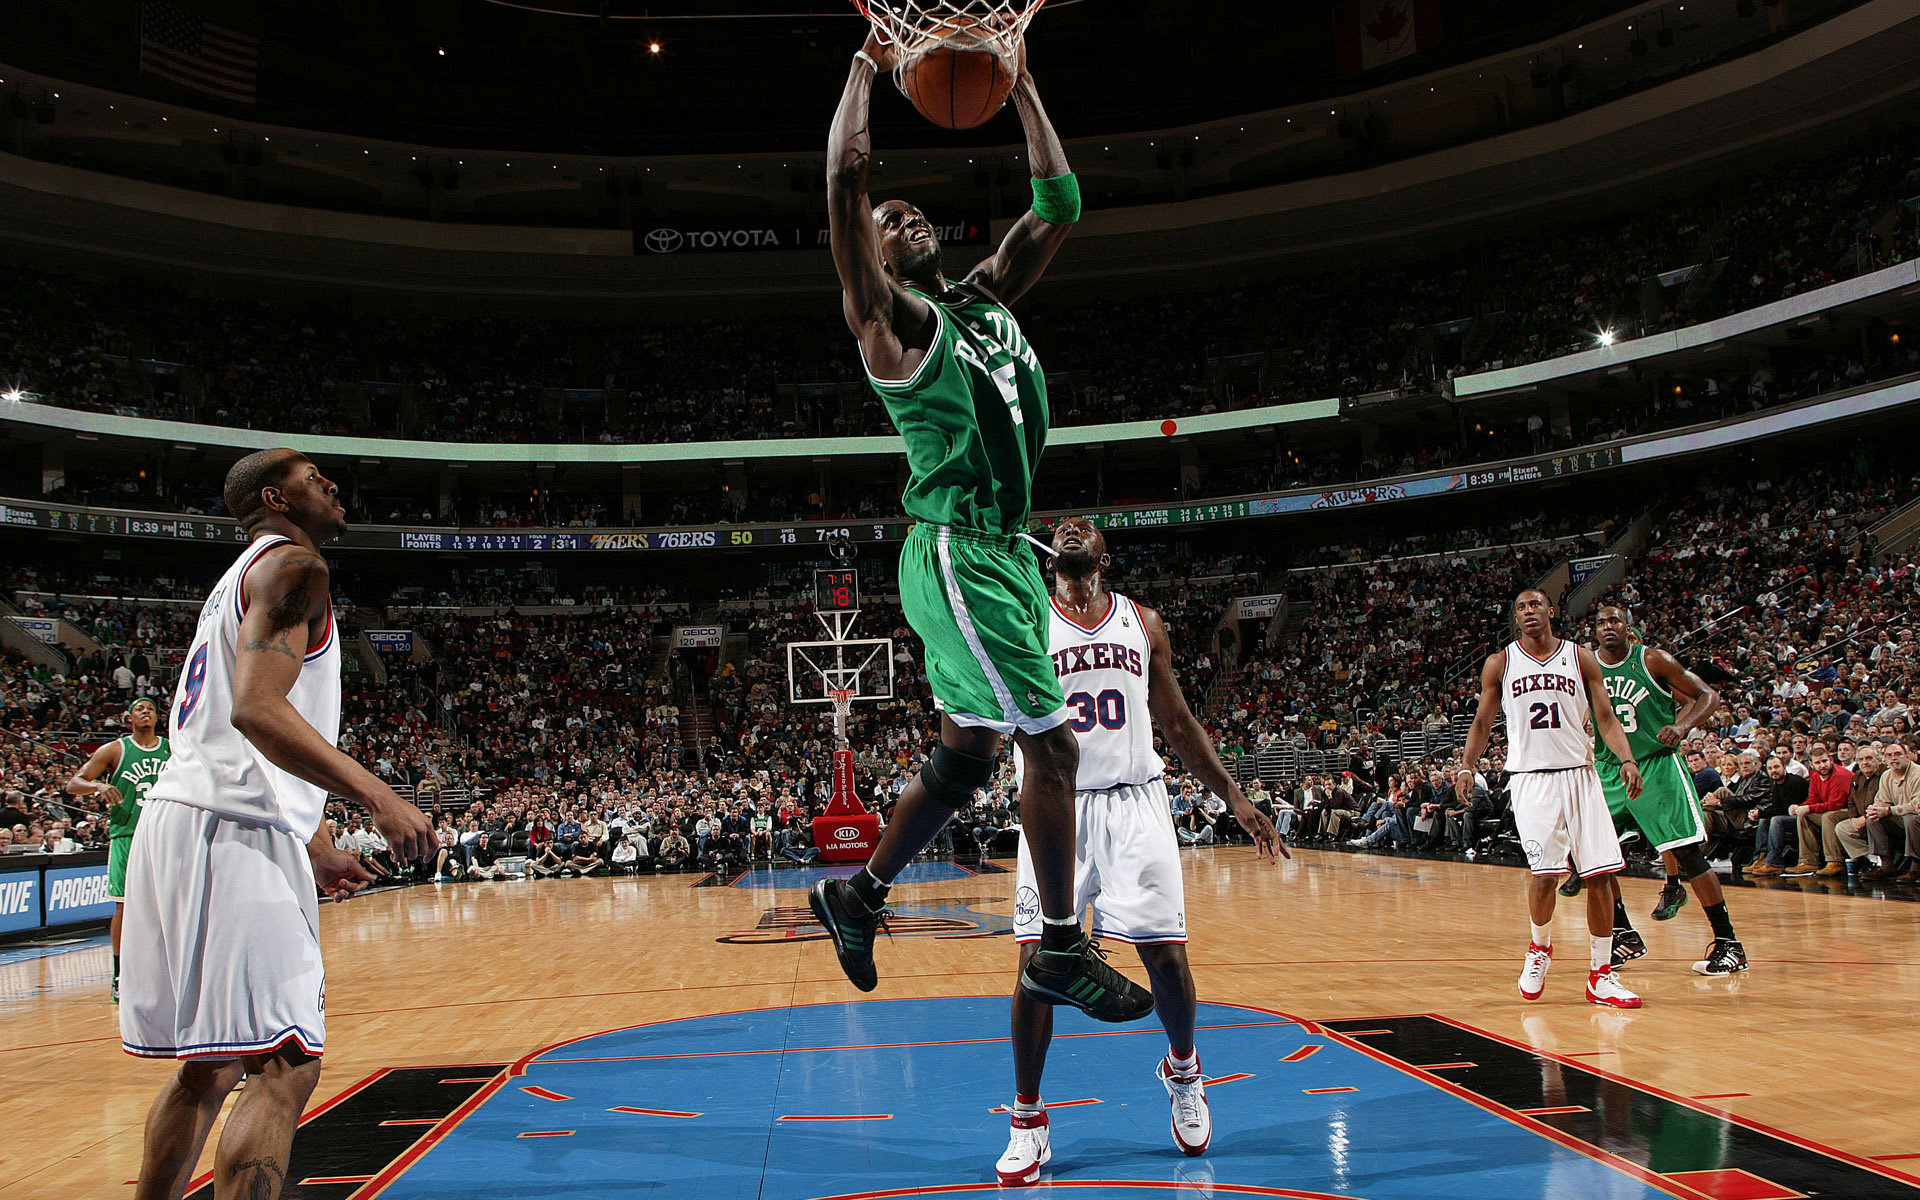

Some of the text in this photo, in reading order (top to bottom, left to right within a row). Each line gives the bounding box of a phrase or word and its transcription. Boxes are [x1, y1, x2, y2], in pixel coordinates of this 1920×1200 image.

[686, 229, 779, 248] TOYOTA
[953, 311, 1038, 376] BSTON
[991, 361, 1024, 426] 5
[1513, 465, 1539, 475] Sixers
[1470, 472, 1495, 486] 8:39
[1513, 471, 1542, 481] Celtics
[6, 508, 35, 519] Sixers
[1134, 509, 1169, 519] PLAYER
[6, 515, 38, 526] Celtics
[1109, 517, 1117, 527] 4
[1122, 517, 1128, 527] 1
[1135, 516, 1169, 526] POINTS
[132, 521, 159, 533] 8:39
[179, 522, 194, 530] ATL
[179, 530, 195, 538] ORL
[235, 533, 249, 541] CLE
[406, 533, 442, 541] PLAYER
[731, 531, 753, 545] 50
[780, 533, 796, 543] 18
[874, 530, 883, 540] 3
[406, 541, 442, 549] POINTS
[533, 539, 542, 549] 2
[556, 539, 565, 549] 3
[570, 539, 576, 549] 1
[658, 532, 715, 548] 76ERS
[828, 573, 852, 584] 7:19
[1572, 573, 1586, 583] 117
[833, 587, 849, 606] 18
[1243, 598, 1277, 607] GEICO
[1240, 609, 1253, 618] 118
[370, 633, 406, 641] GEICO
[682, 628, 717, 636] GEICO
[42, 633, 56, 642] 121
[680, 638, 695, 646] 120
[707, 637, 720, 645] 119
[394, 643, 411, 651] 120
[1051, 642, 1142, 679] SIXERS
[177, 641, 209, 731] 9
[1511, 673, 1576, 698] SIXERS
[1603, 675, 1650, 707] STON
[1065, 688, 1126, 733] 30
[1529, 702, 1562, 730] 21
[1614, 703, 1638, 733] 3
[121, 757, 168, 785] BOSTO
[135, 782, 152, 807] 3
[839, 830, 855, 838] KIA
[48, 874, 109, 912] PROGRE
